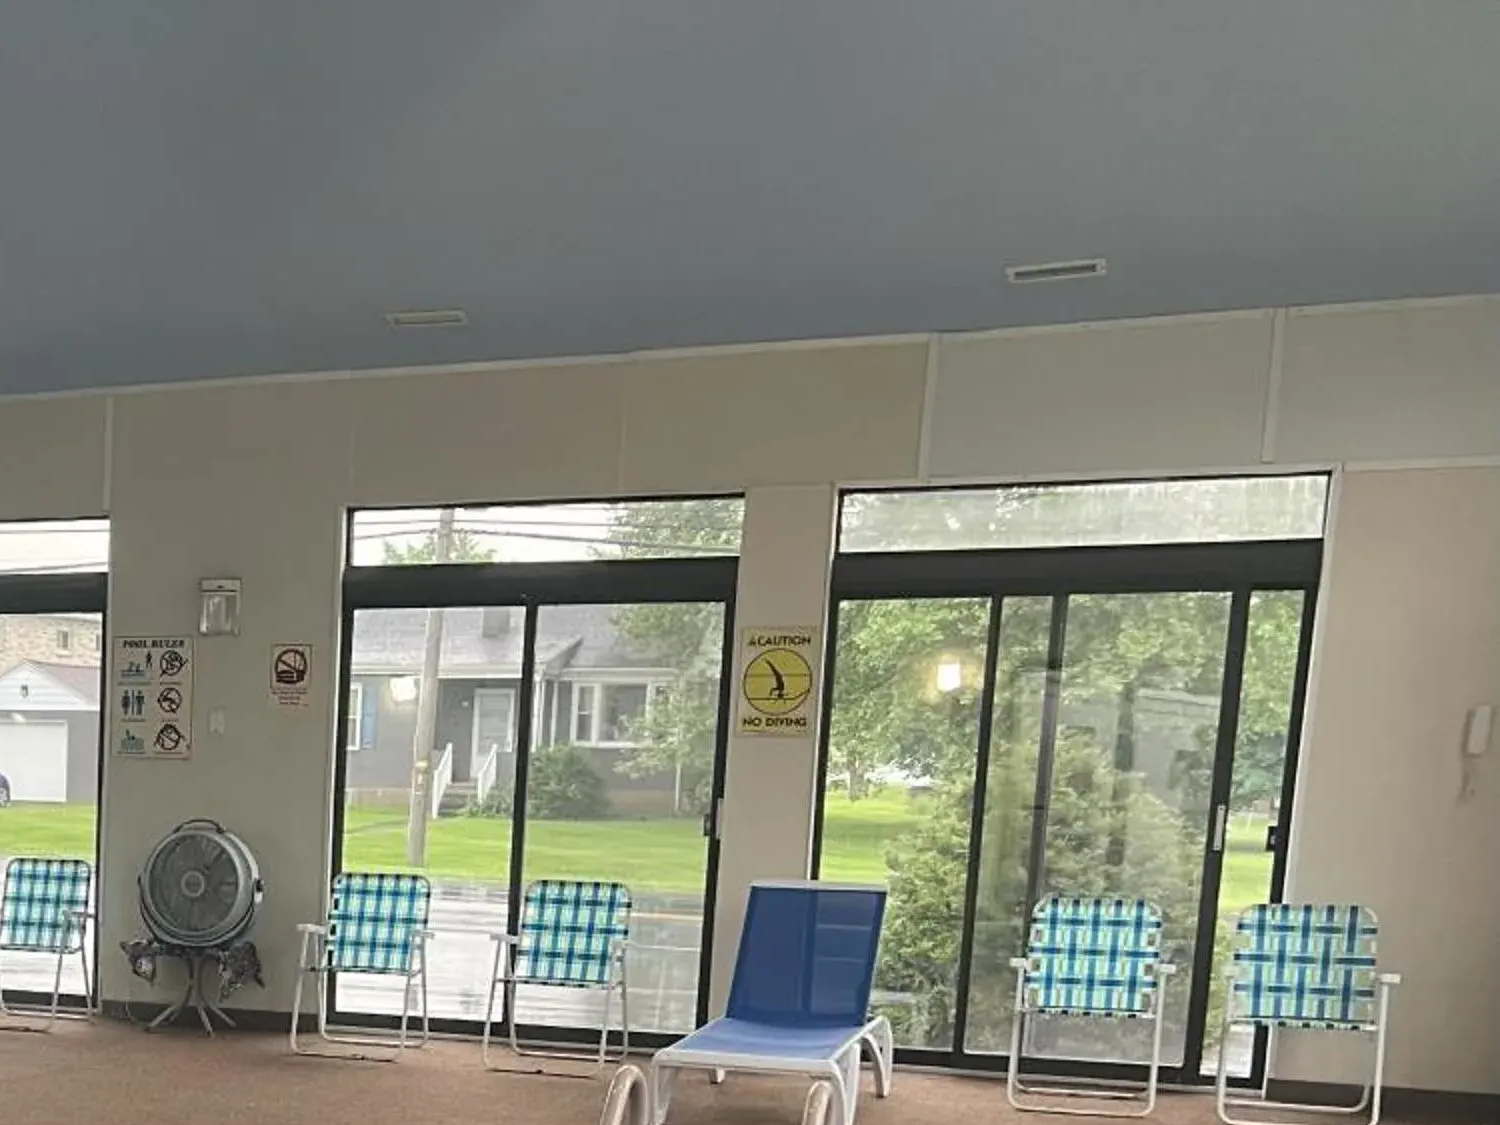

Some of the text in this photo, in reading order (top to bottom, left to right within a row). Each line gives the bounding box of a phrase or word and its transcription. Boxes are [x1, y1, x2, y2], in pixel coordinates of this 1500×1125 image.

[123, 639, 147, 649] POOL
[758, 635, 811, 646] CAUTION
[743, 717, 807, 727] NO DIVING
